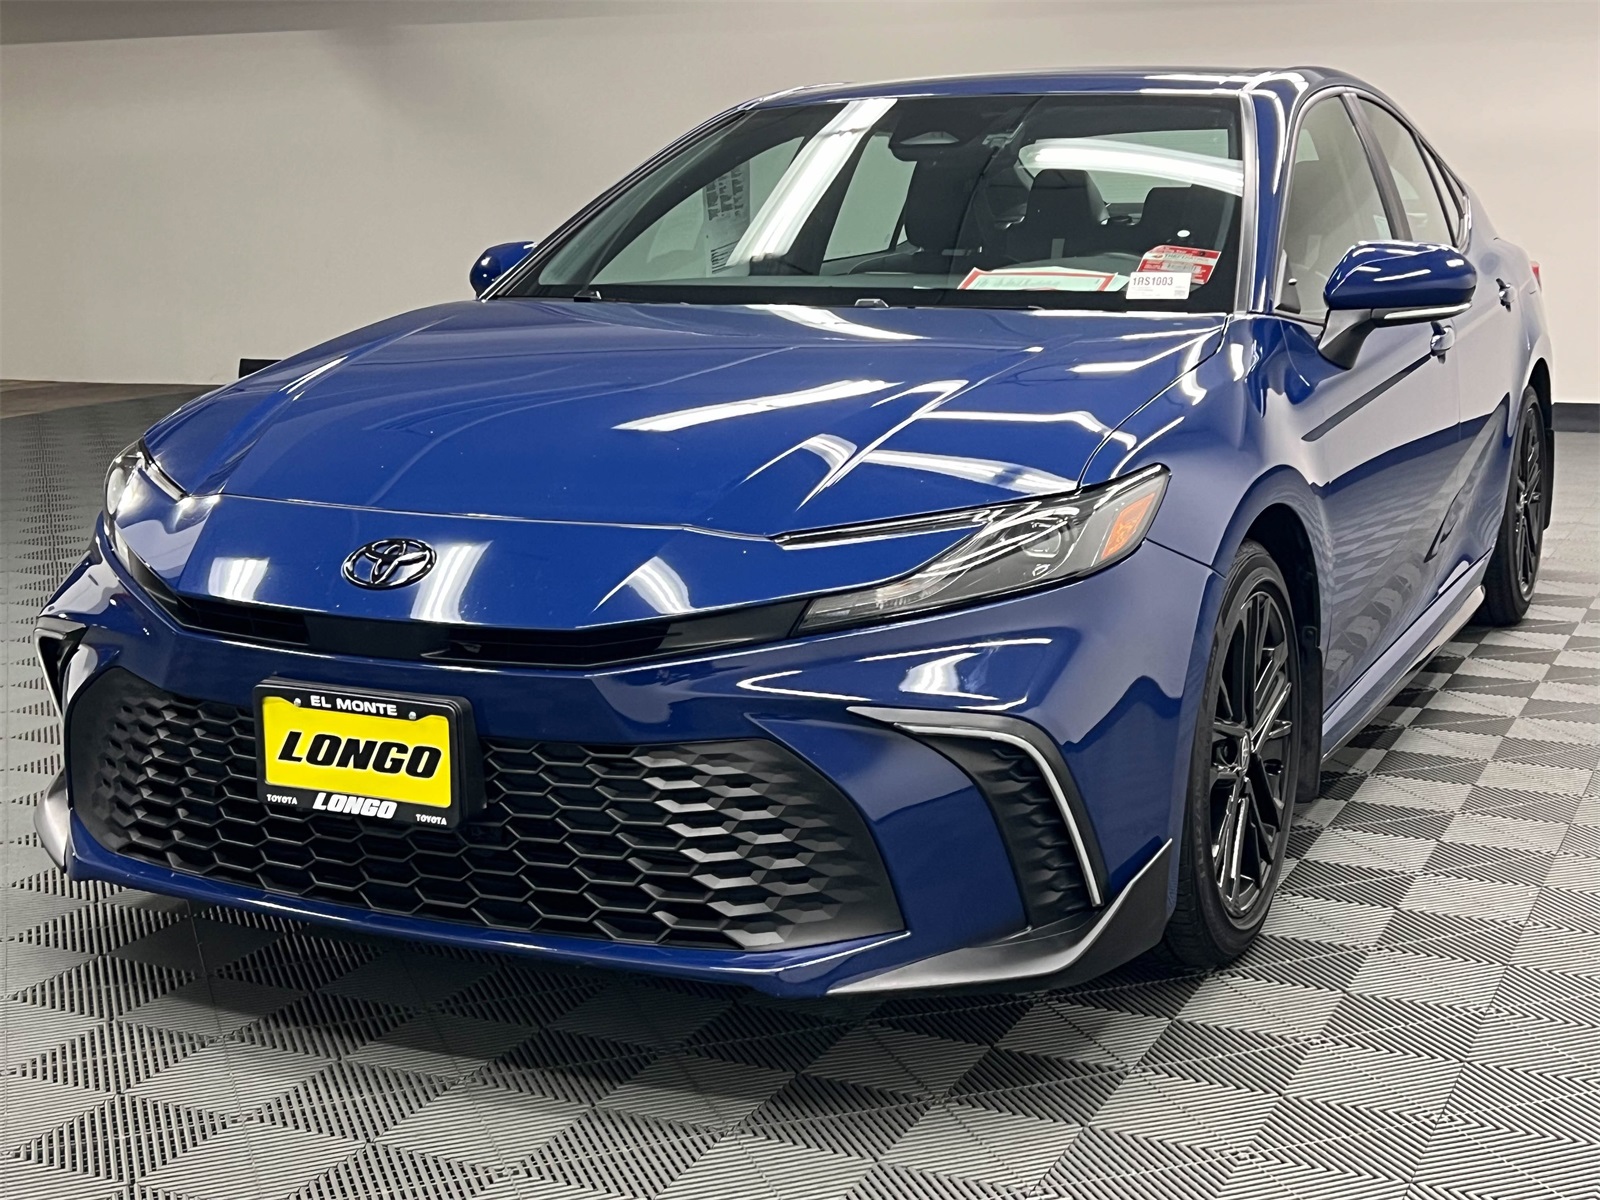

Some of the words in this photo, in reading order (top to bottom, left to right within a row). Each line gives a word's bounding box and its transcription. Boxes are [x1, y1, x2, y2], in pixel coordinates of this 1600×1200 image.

[310, 695, 332, 708] EL
[336, 699, 397, 716] MONTE
[278, 731, 442, 778] LONGO
[266, 794, 297, 805] TOYOTA
[312, 792, 397, 819] LONGO
[416, 814, 447, 825] TOYOTA
